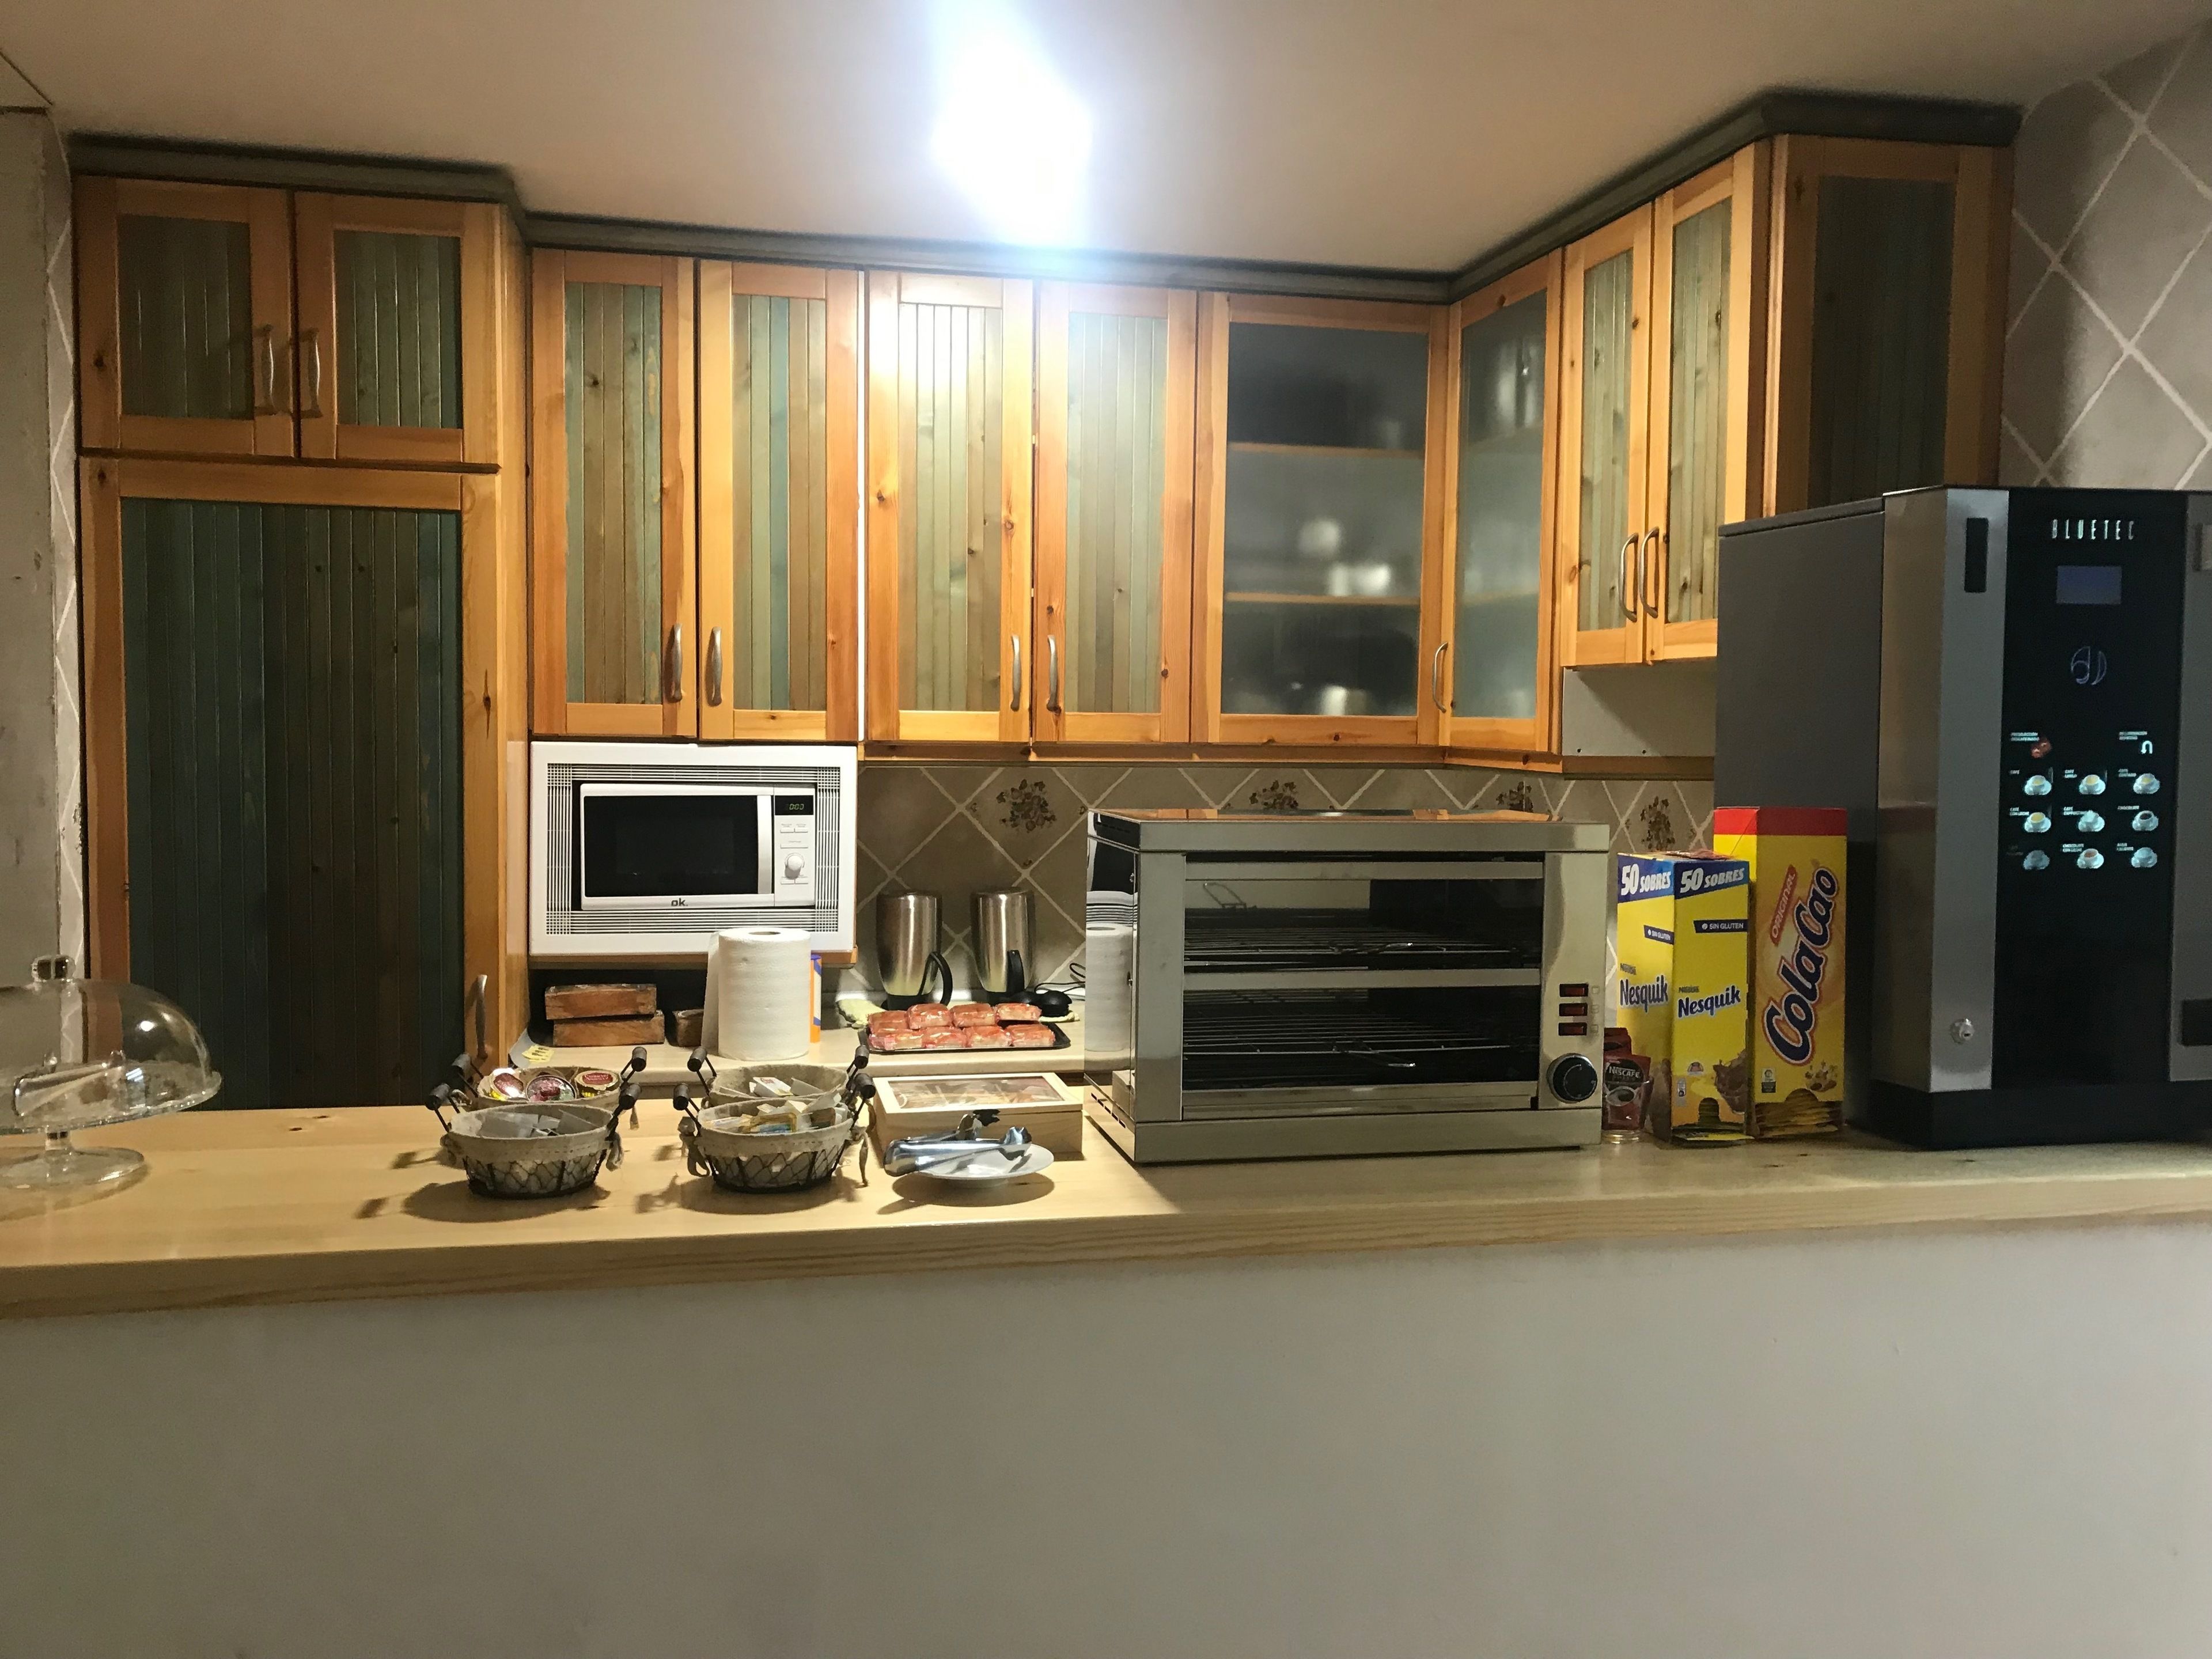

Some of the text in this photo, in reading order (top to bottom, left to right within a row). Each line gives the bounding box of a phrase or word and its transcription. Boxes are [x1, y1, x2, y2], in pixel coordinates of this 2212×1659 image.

[2052, 519, 2134, 540] BLUETEC
[1621, 863, 1672, 896] 50 SOBRES
[1680, 868, 1745, 893] 50 SOBRES
[1620, 975, 1669, 1013] Nesquik
[1677, 984, 1741, 1018] Nesquik
